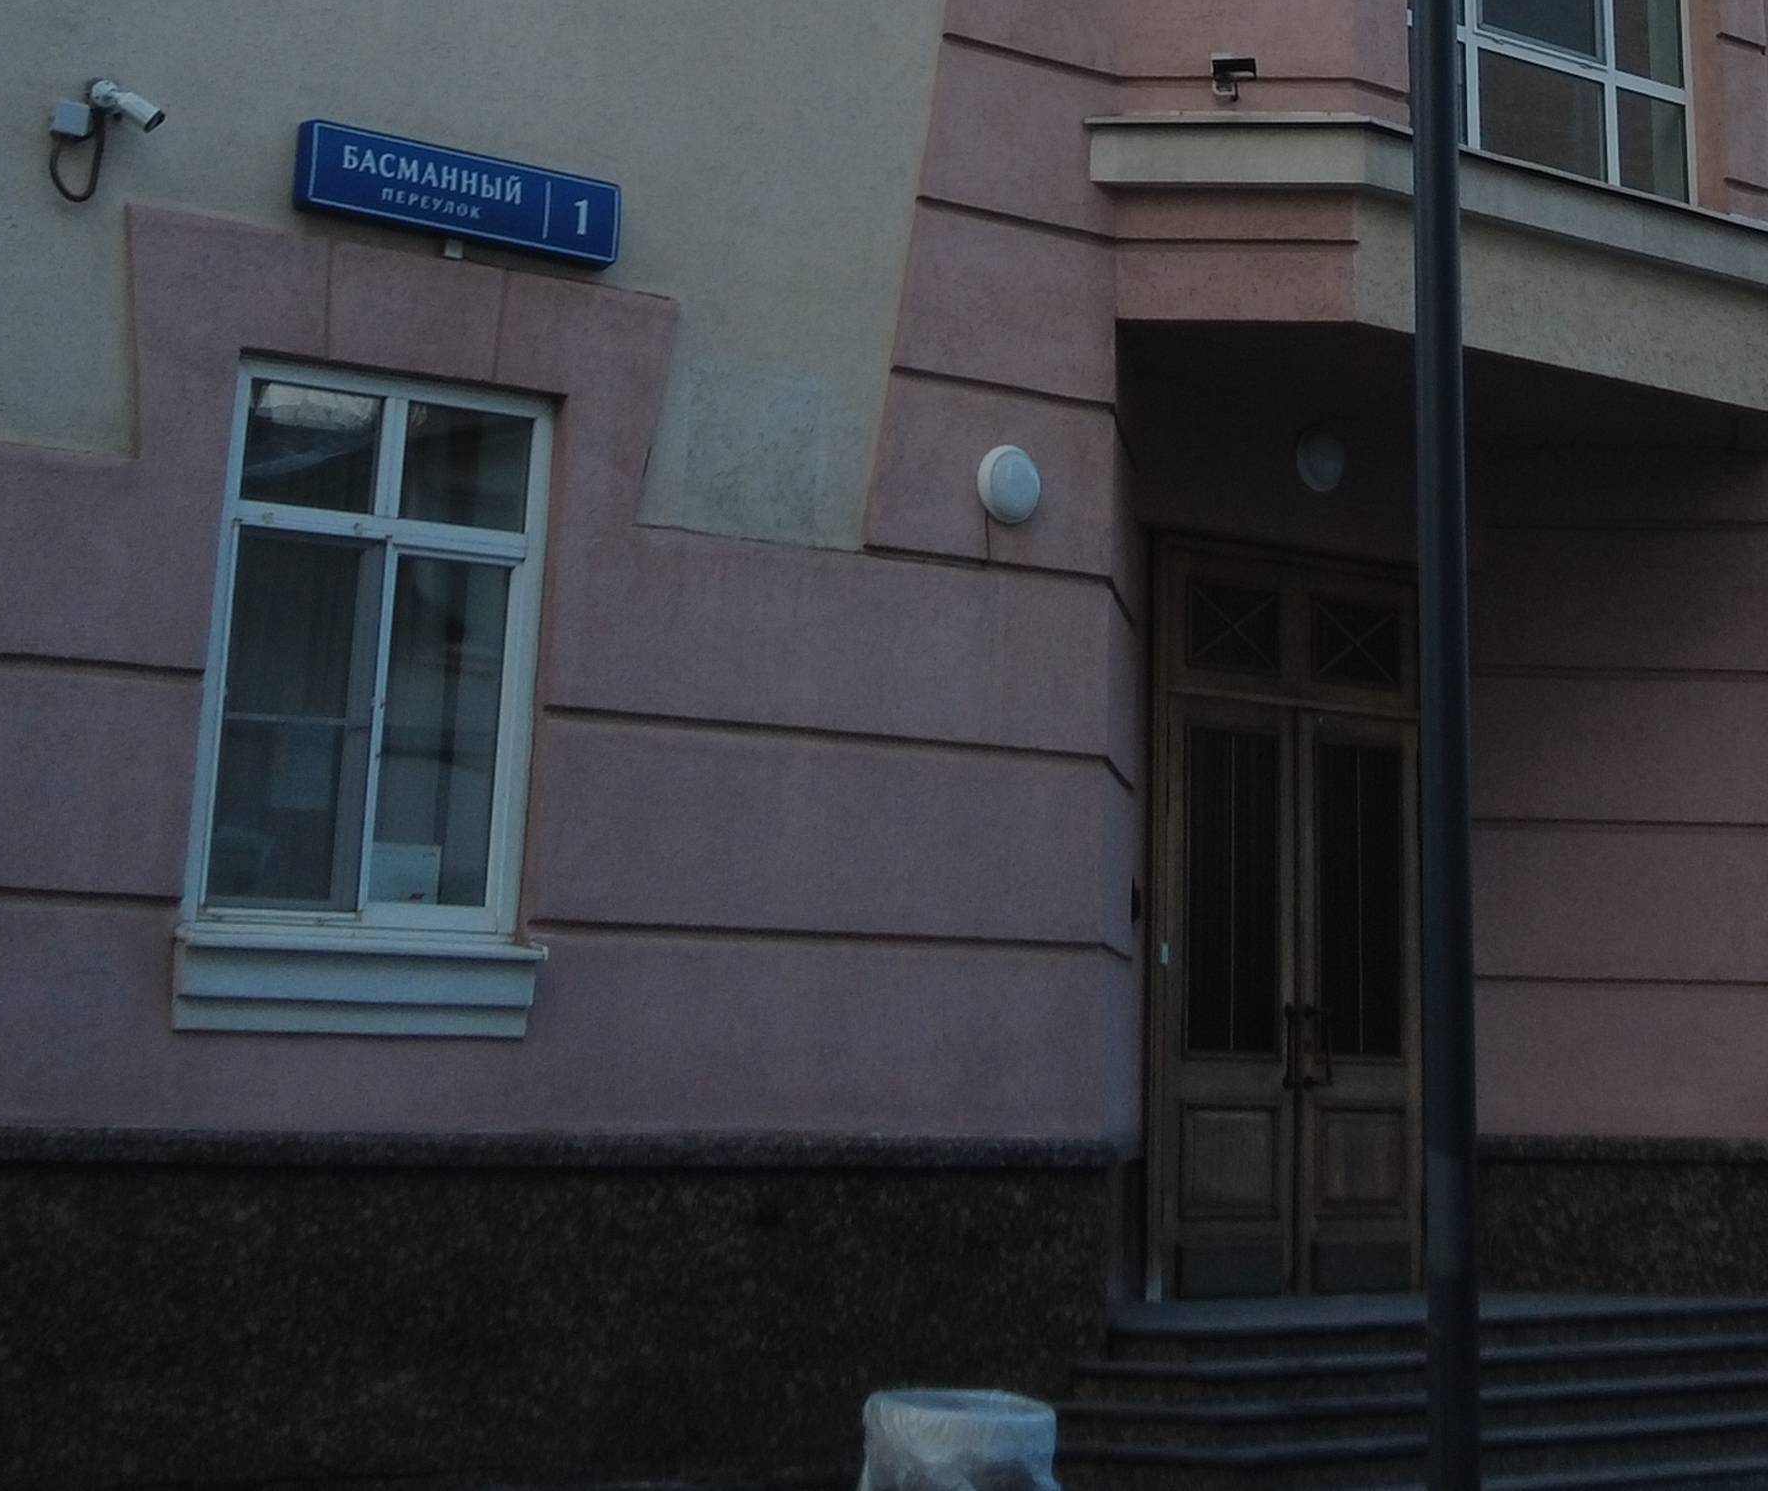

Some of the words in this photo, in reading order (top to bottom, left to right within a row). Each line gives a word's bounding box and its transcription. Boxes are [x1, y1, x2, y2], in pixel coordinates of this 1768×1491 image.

[342, 143, 522, 205] БАСМАННЫЙ
[574, 198, 589, 236] 1
[382, 186, 482, 220] ПЕРЕУЛОК
